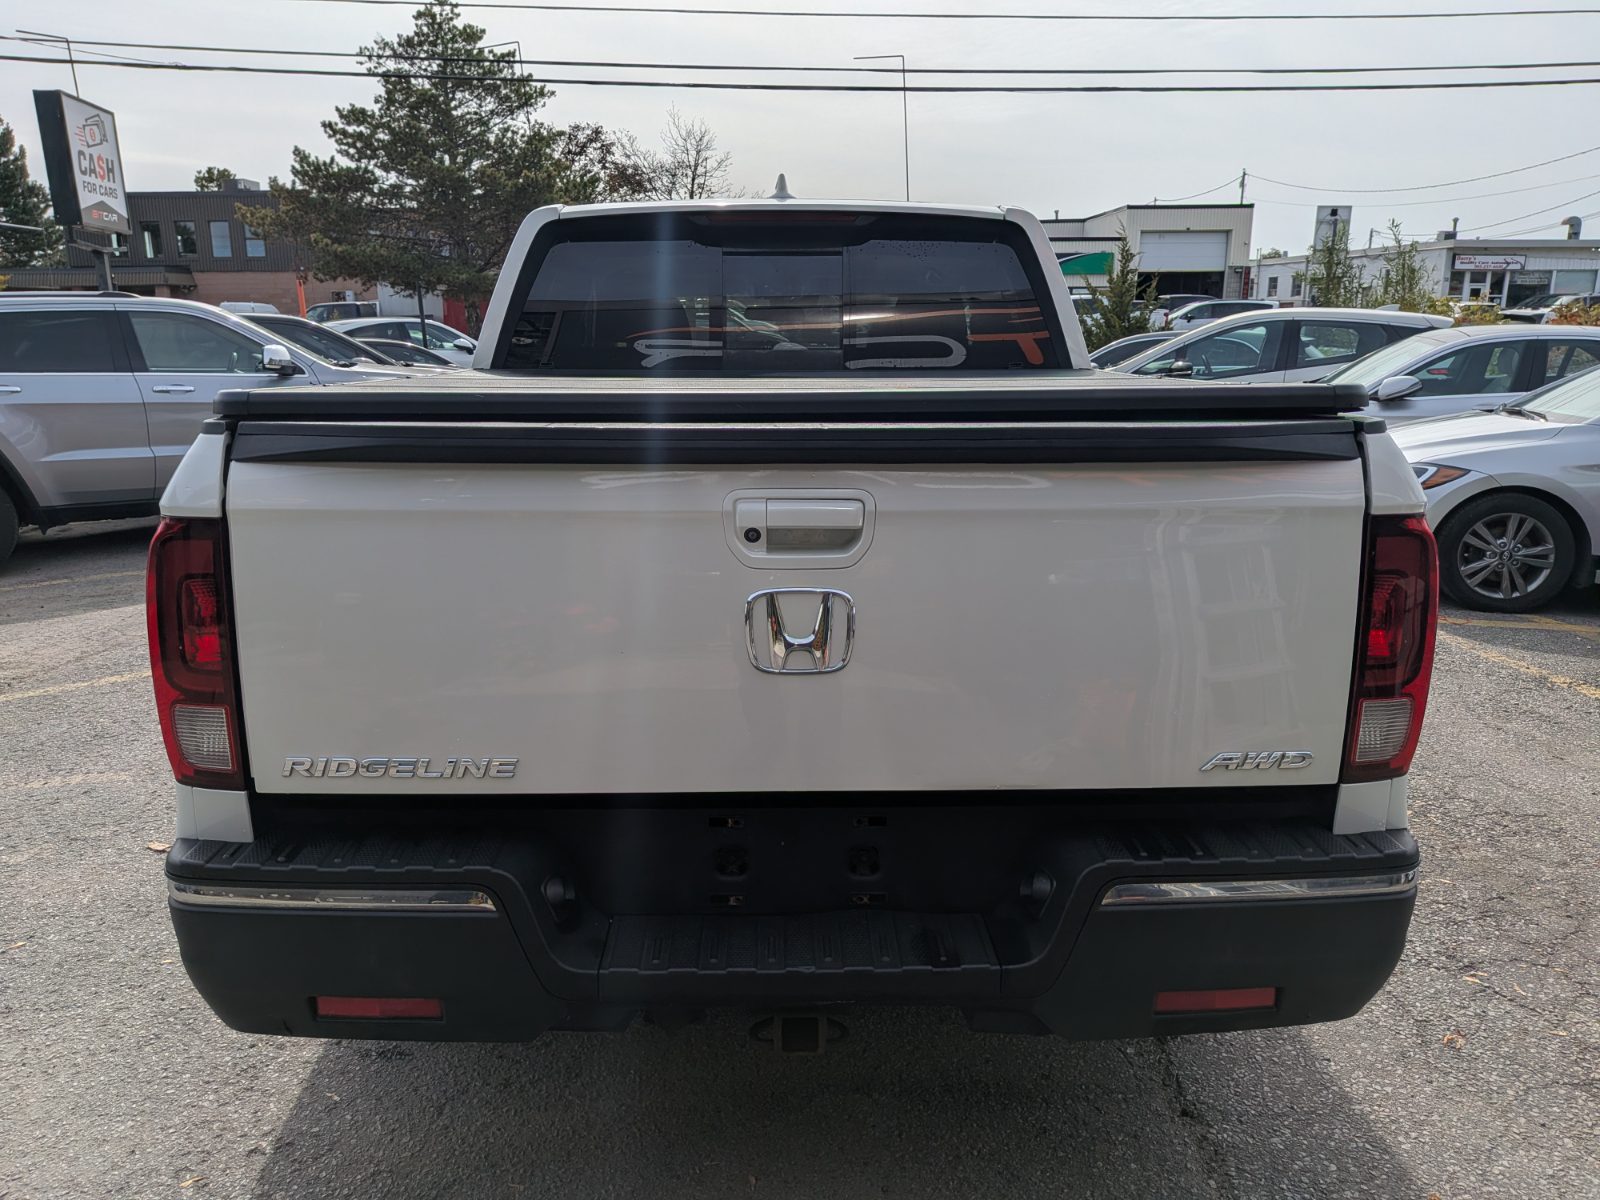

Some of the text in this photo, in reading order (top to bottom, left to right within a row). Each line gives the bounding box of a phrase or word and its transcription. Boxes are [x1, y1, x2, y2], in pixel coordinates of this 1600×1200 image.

[82, 180, 118, 199] FOR CARS
[281, 756, 520, 779] RIDGELINE
[1199, 750, 1313, 771] AWD
